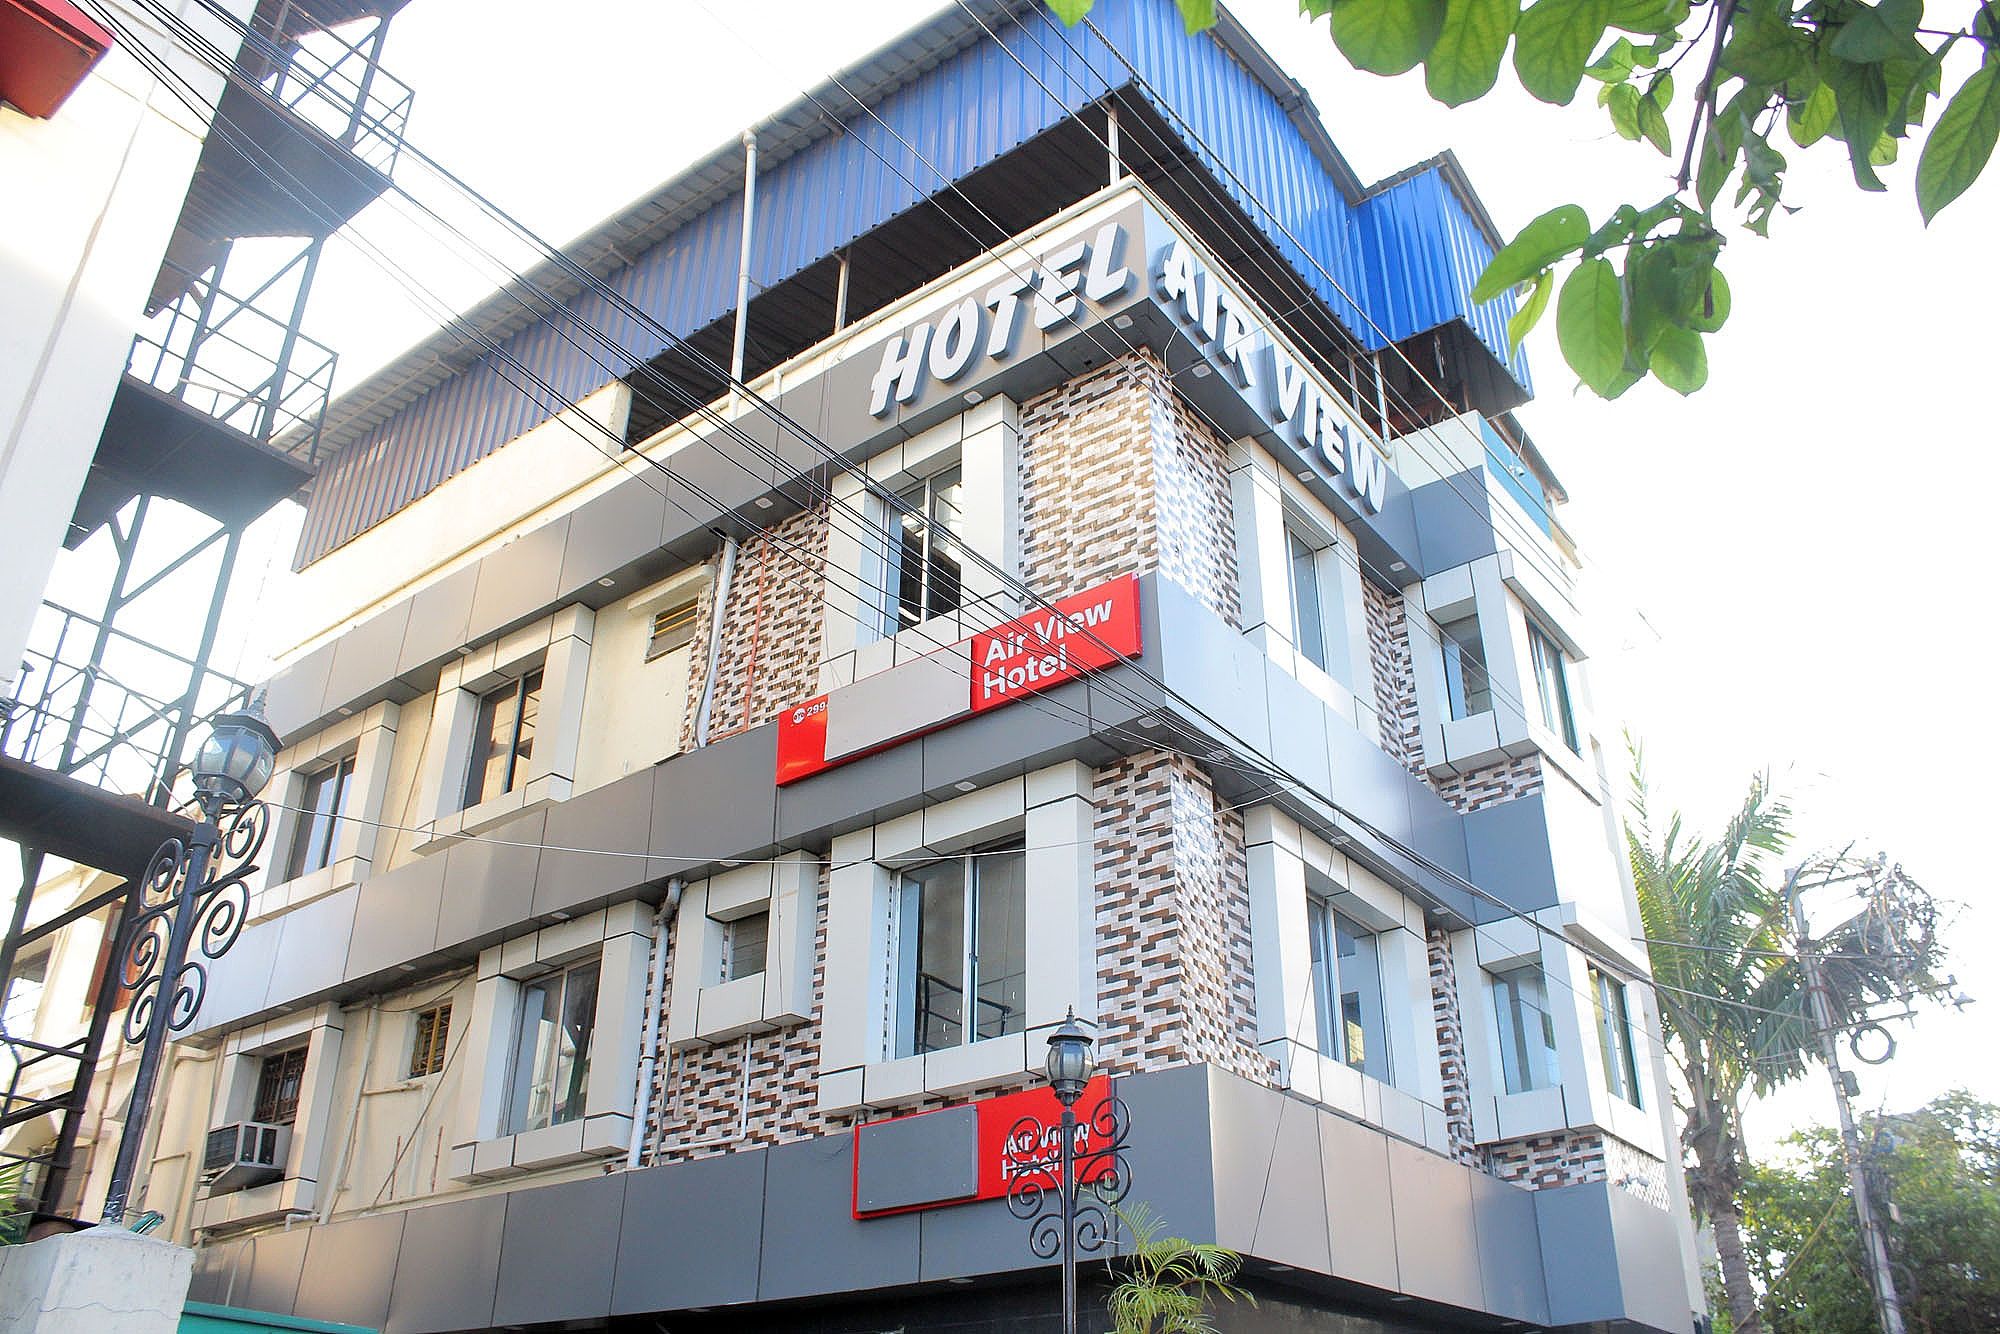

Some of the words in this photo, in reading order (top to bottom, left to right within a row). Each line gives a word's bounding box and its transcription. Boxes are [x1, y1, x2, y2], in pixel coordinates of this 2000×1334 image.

[869, 222, 1131, 419] HOTEL
[1161, 237, 1258, 388] AIR
[1271, 343, 1387, 514] VIEW
[983, 631, 1029, 668] Air
[1033, 599, 1113, 646] View
[983, 643, 1067, 699] Hotel
